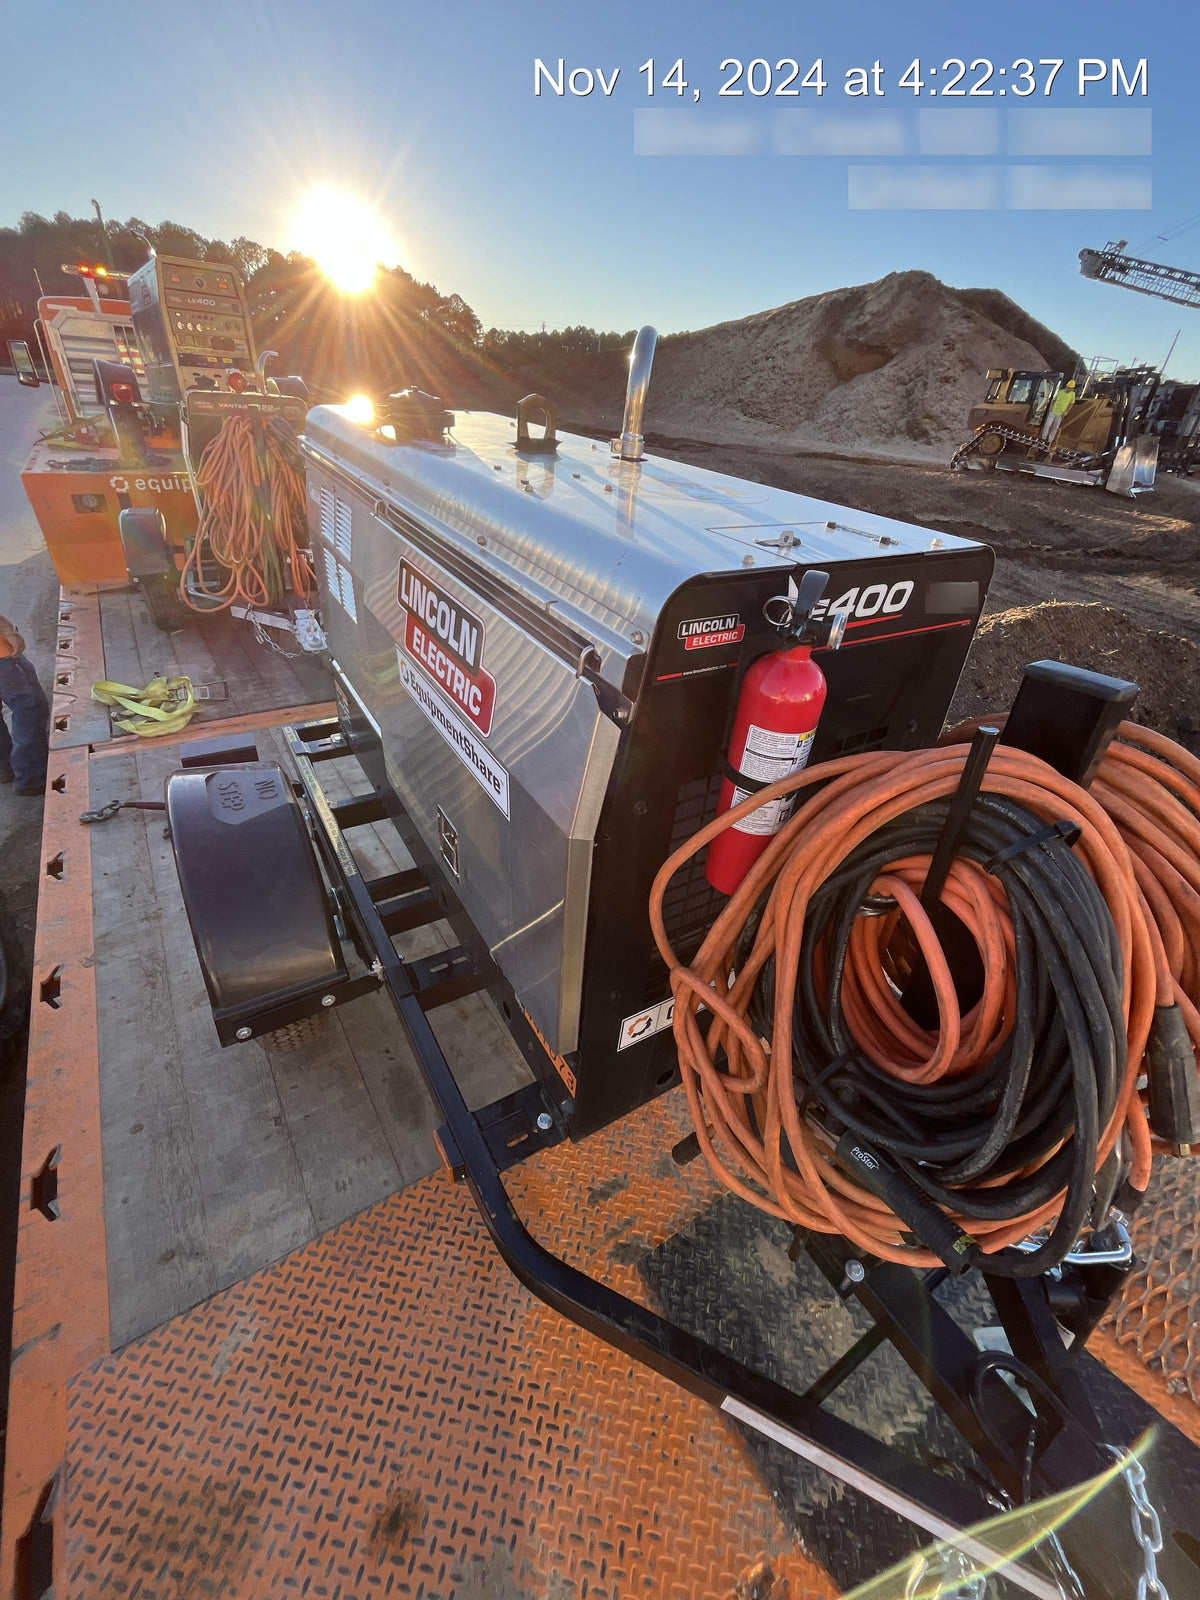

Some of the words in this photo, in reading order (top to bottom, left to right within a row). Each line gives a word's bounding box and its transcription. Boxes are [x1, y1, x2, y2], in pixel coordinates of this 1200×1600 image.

[400, 567, 478, 667] LINCOLN
[681, 617, 736, 636] LINCOLN
[692, 631, 739, 647] ELECTRIC
[412, 625, 482, 717] ELECTRIC
[409, 671, 502, 795] EquipmentShare
[216, 782, 244, 811] STEP
[254, 780, 279, 800] NO
[851, 1146, 877, 1170] ProStar
